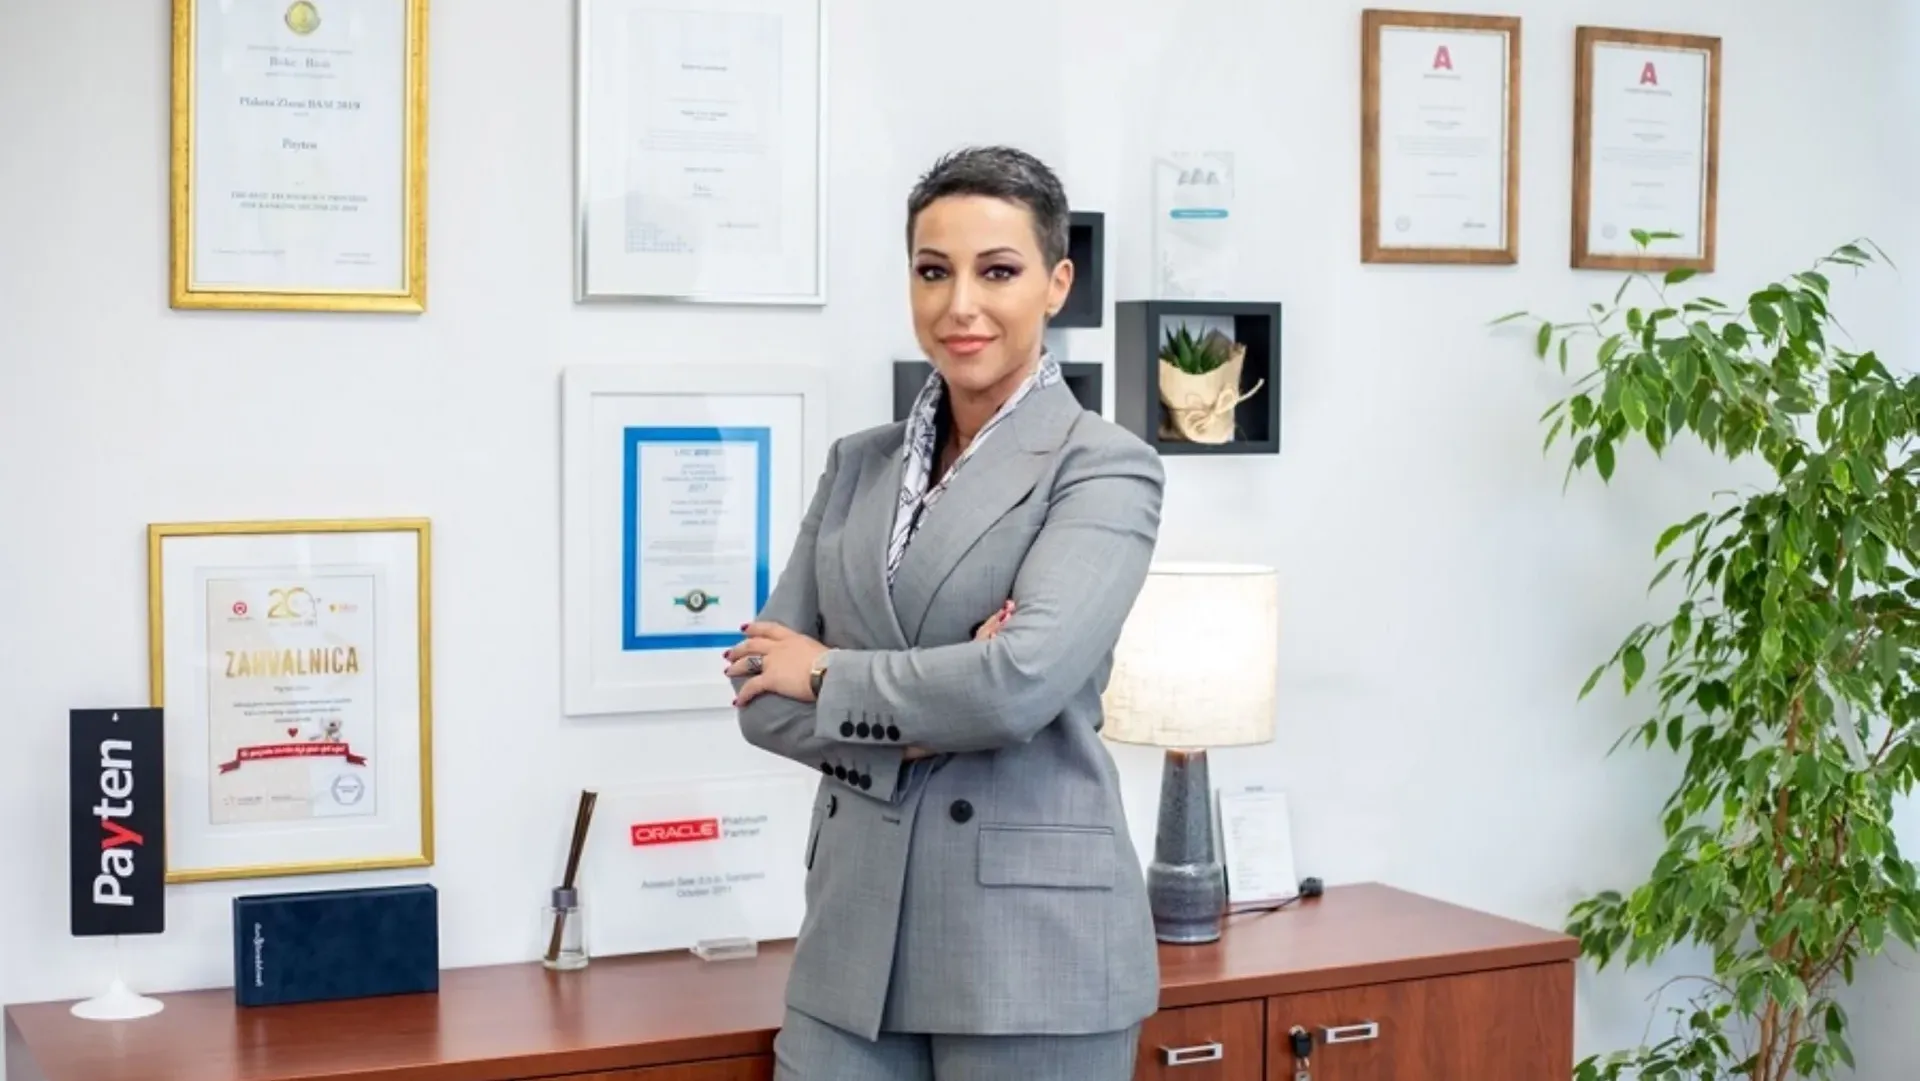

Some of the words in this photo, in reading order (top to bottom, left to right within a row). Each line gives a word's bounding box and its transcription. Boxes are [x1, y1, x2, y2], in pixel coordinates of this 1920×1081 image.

[225, 646, 359, 679] ZAHVALNICA
[92, 738, 144, 907] Payten
[635, 823, 714, 841] ORACLE
